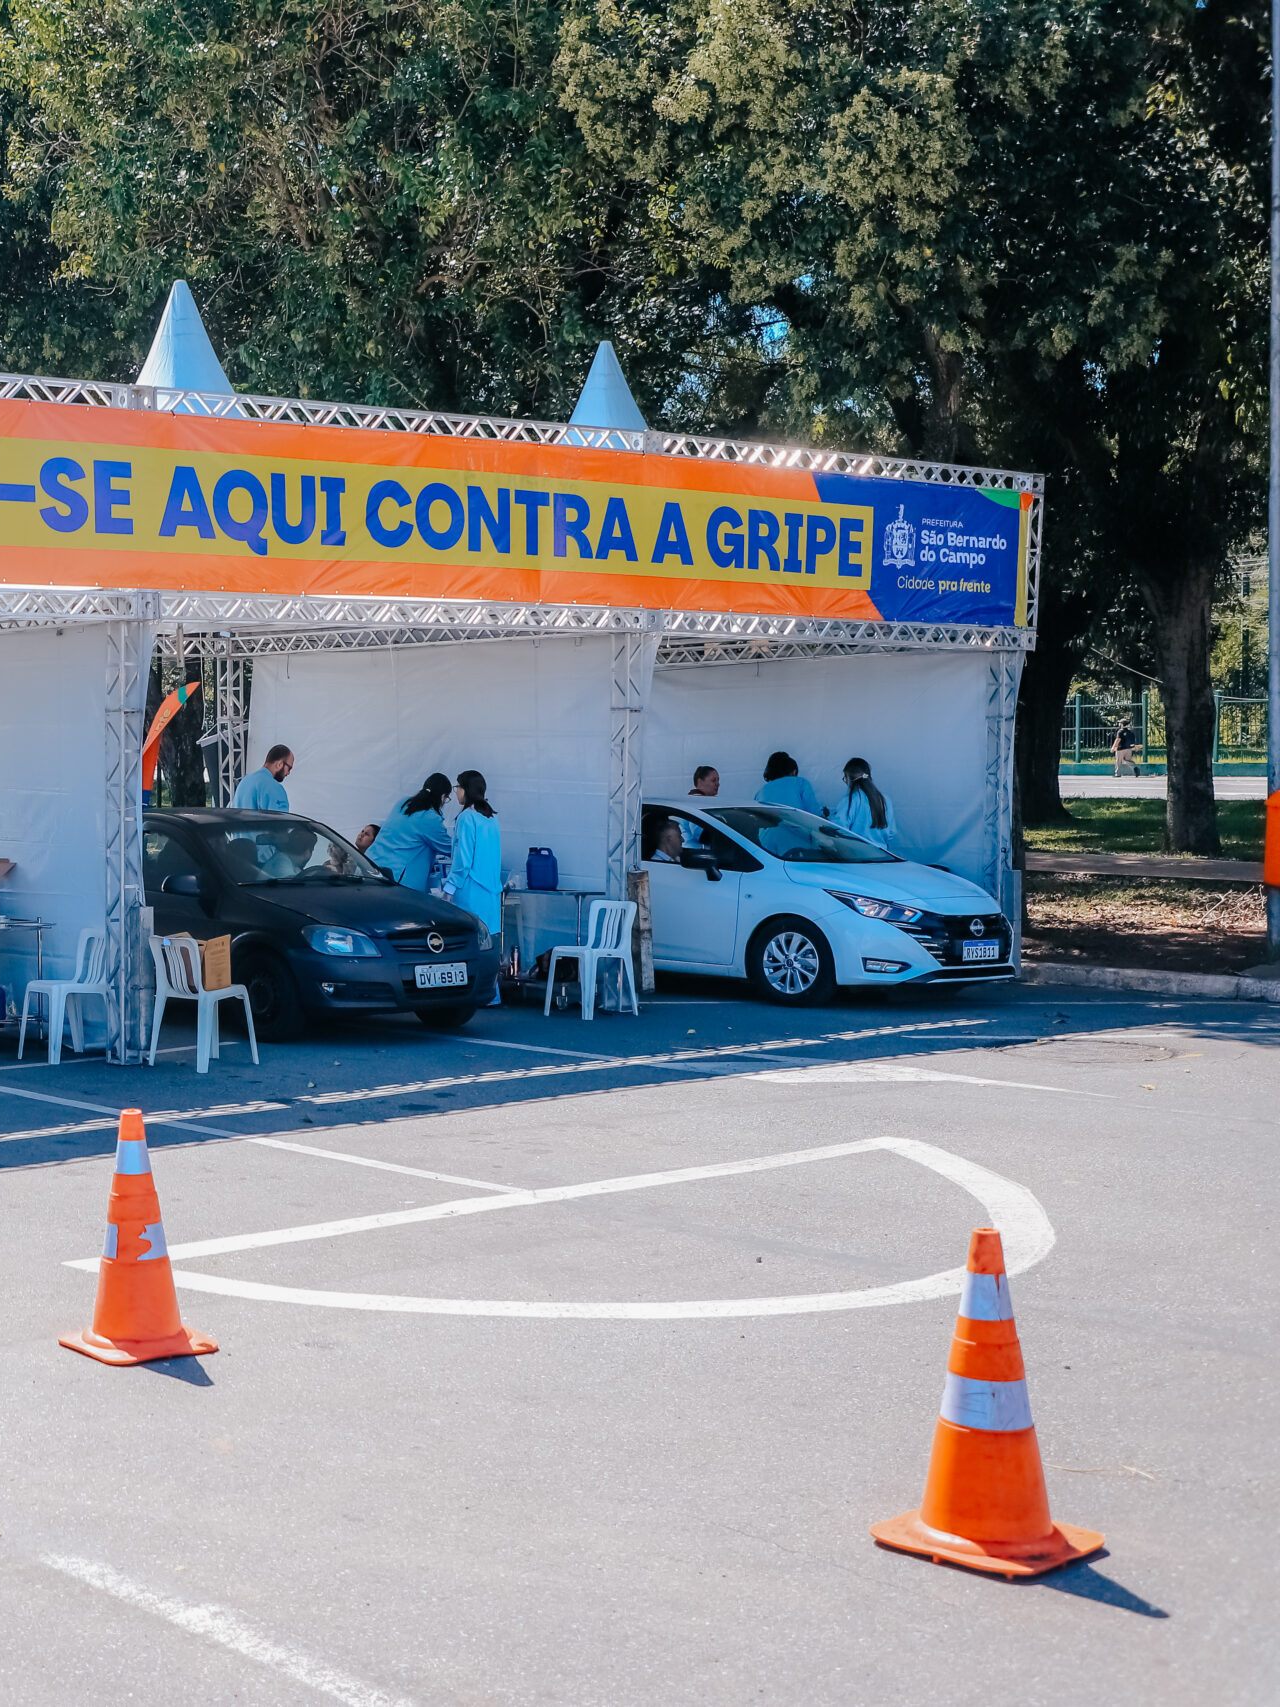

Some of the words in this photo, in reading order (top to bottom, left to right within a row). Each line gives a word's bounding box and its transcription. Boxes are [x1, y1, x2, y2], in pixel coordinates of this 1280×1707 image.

[158, 465, 346, 555] AQUI
[366, 480, 639, 562] CONTRA
[651, 501, 694, 566] A
[706, 506, 864, 577] GRIPE
[921, 518, 963, 528] PREFEITURA
[920, 529, 945, 546] São
[947, 531, 1007, 550] Bernardo
[920, 545, 936, 562] do
[939, 548, 986, 569] Campo
[897, 575, 936, 590] Cidade
[938, 578, 958, 595] pra
[959, 578, 991, 593] frente
